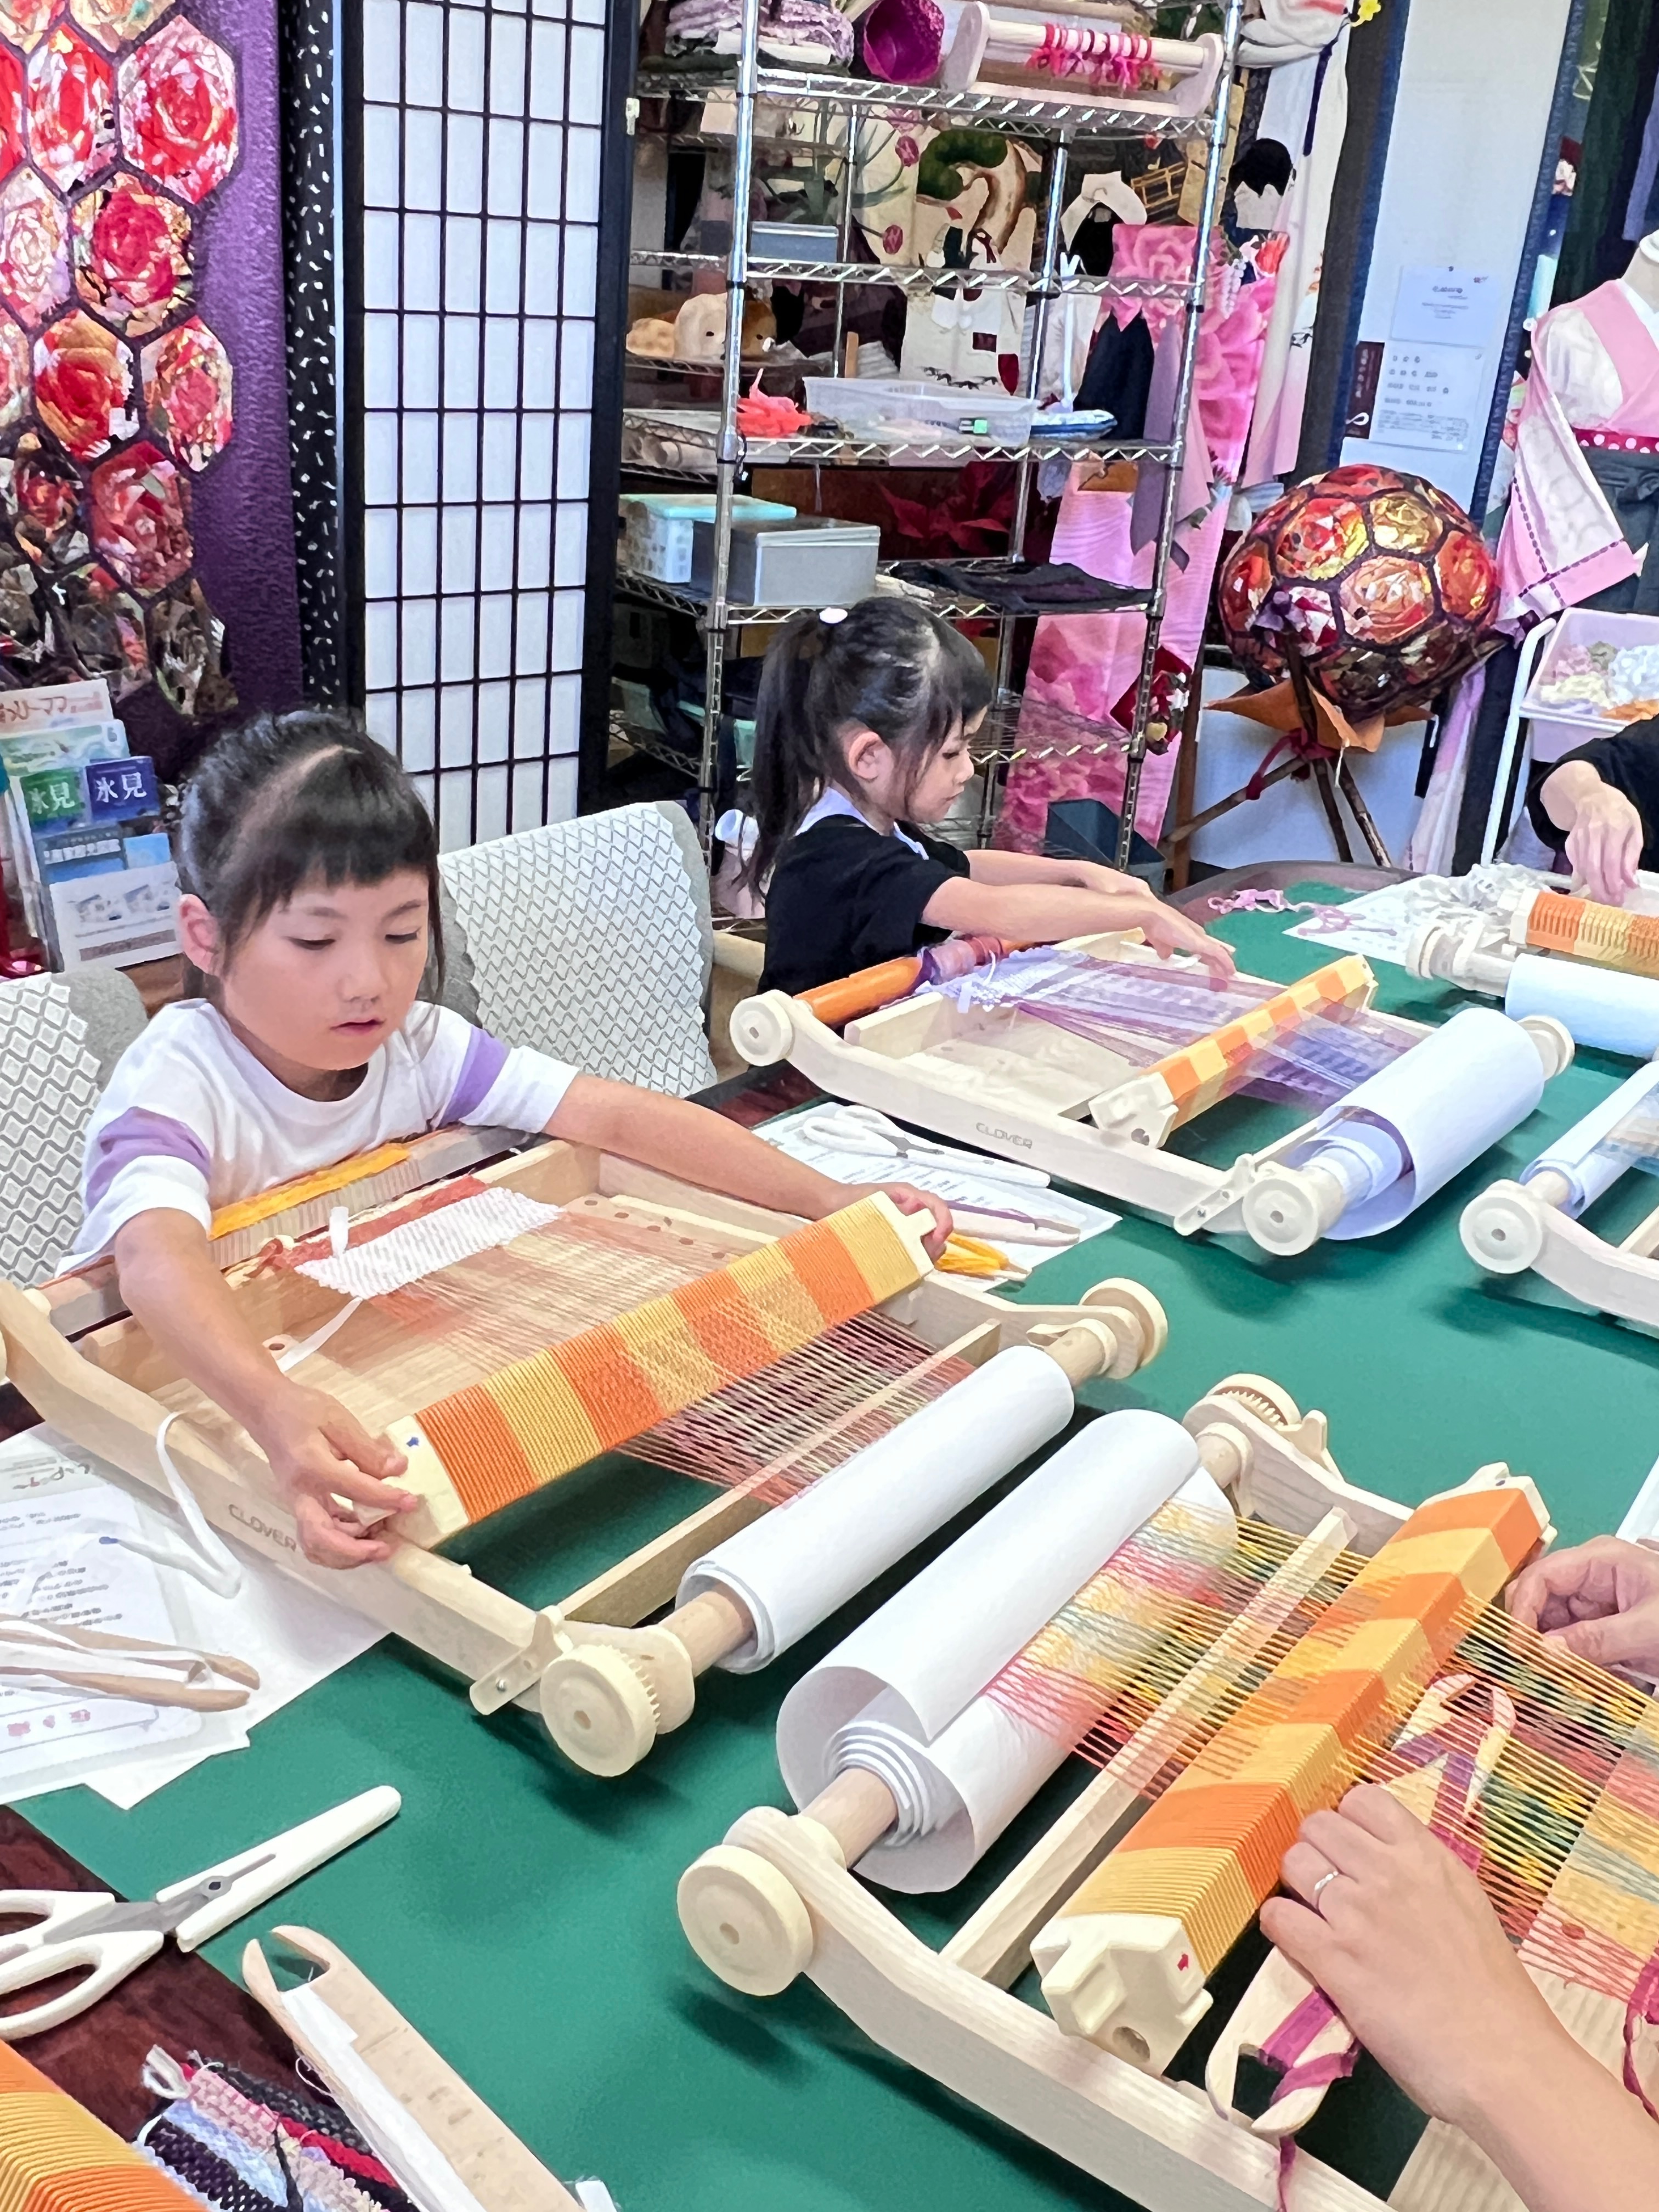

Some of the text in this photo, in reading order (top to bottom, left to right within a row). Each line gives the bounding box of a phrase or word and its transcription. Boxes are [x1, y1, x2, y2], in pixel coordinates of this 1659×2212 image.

[96, 772, 148, 803] 氷見
[976, 1122, 1032, 1149] CLOVER
[228, 1504, 297, 1552] CLOVER
